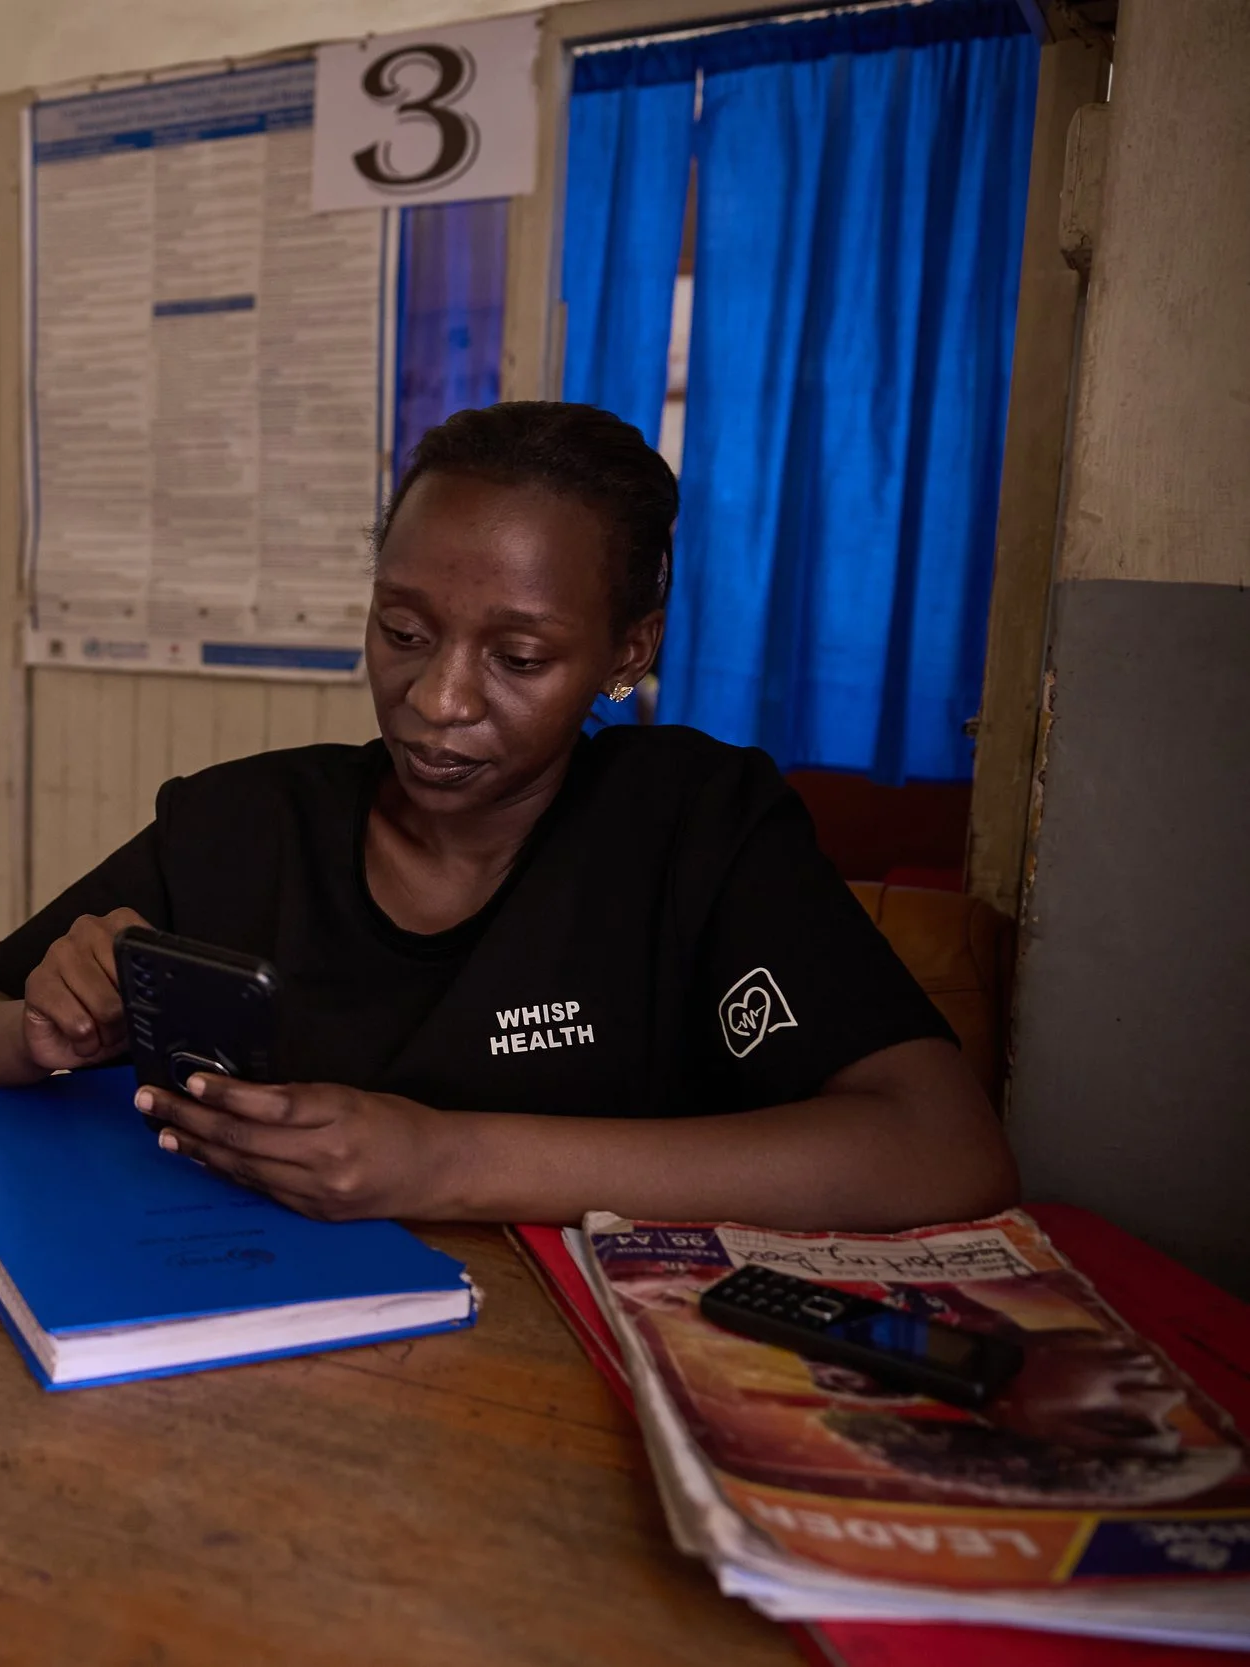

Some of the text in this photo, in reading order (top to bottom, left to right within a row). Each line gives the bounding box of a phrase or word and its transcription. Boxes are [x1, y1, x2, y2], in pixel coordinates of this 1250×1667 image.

[352, 42, 481, 194] 3
[495, 1001, 581, 1029] WHISP
[489, 1024, 595, 1055] HEALTH
[616, 1235, 651, 1246] A4
[654, 1247, 720, 1258] EXERCISE
[670, 1236, 707, 1248] 96
[748, 1498, 1039, 1560] LEADER
